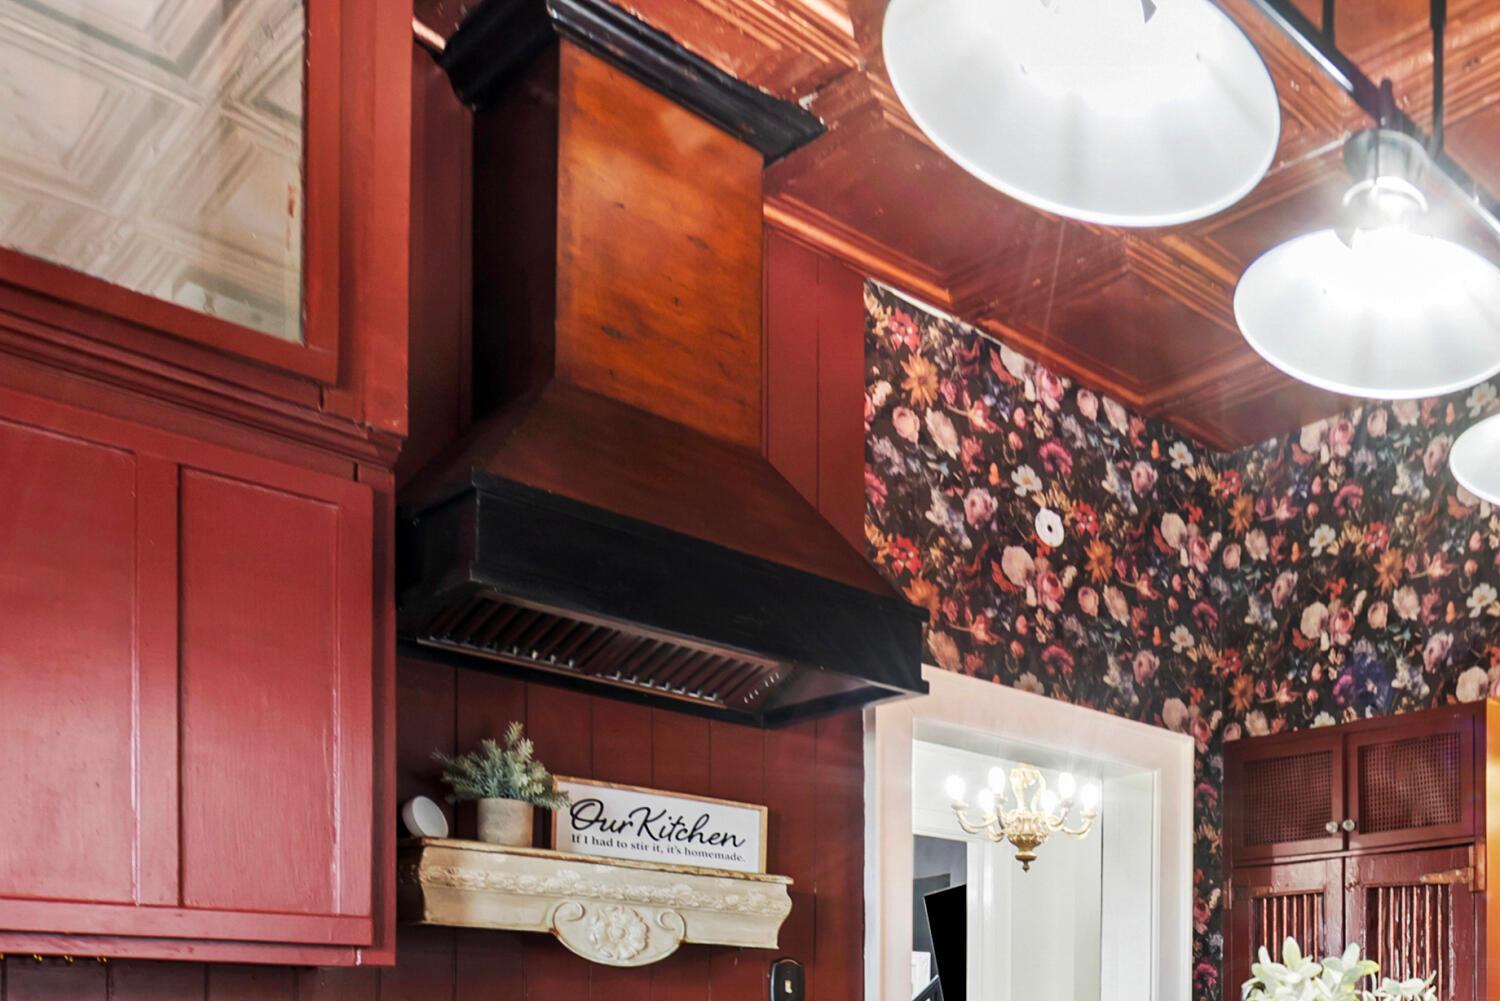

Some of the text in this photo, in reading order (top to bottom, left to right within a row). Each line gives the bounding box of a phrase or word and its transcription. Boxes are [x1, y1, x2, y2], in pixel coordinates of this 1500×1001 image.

[569, 798, 746, 848] Our Kitchen
[572, 834, 581, 844] If
[592, 836, 613, 847] had
[616, 838, 629, 849] to
[630, 840, 649, 851] stir
[666, 845, 682, 855] it's
[684, 847, 746, 862] homemade.
